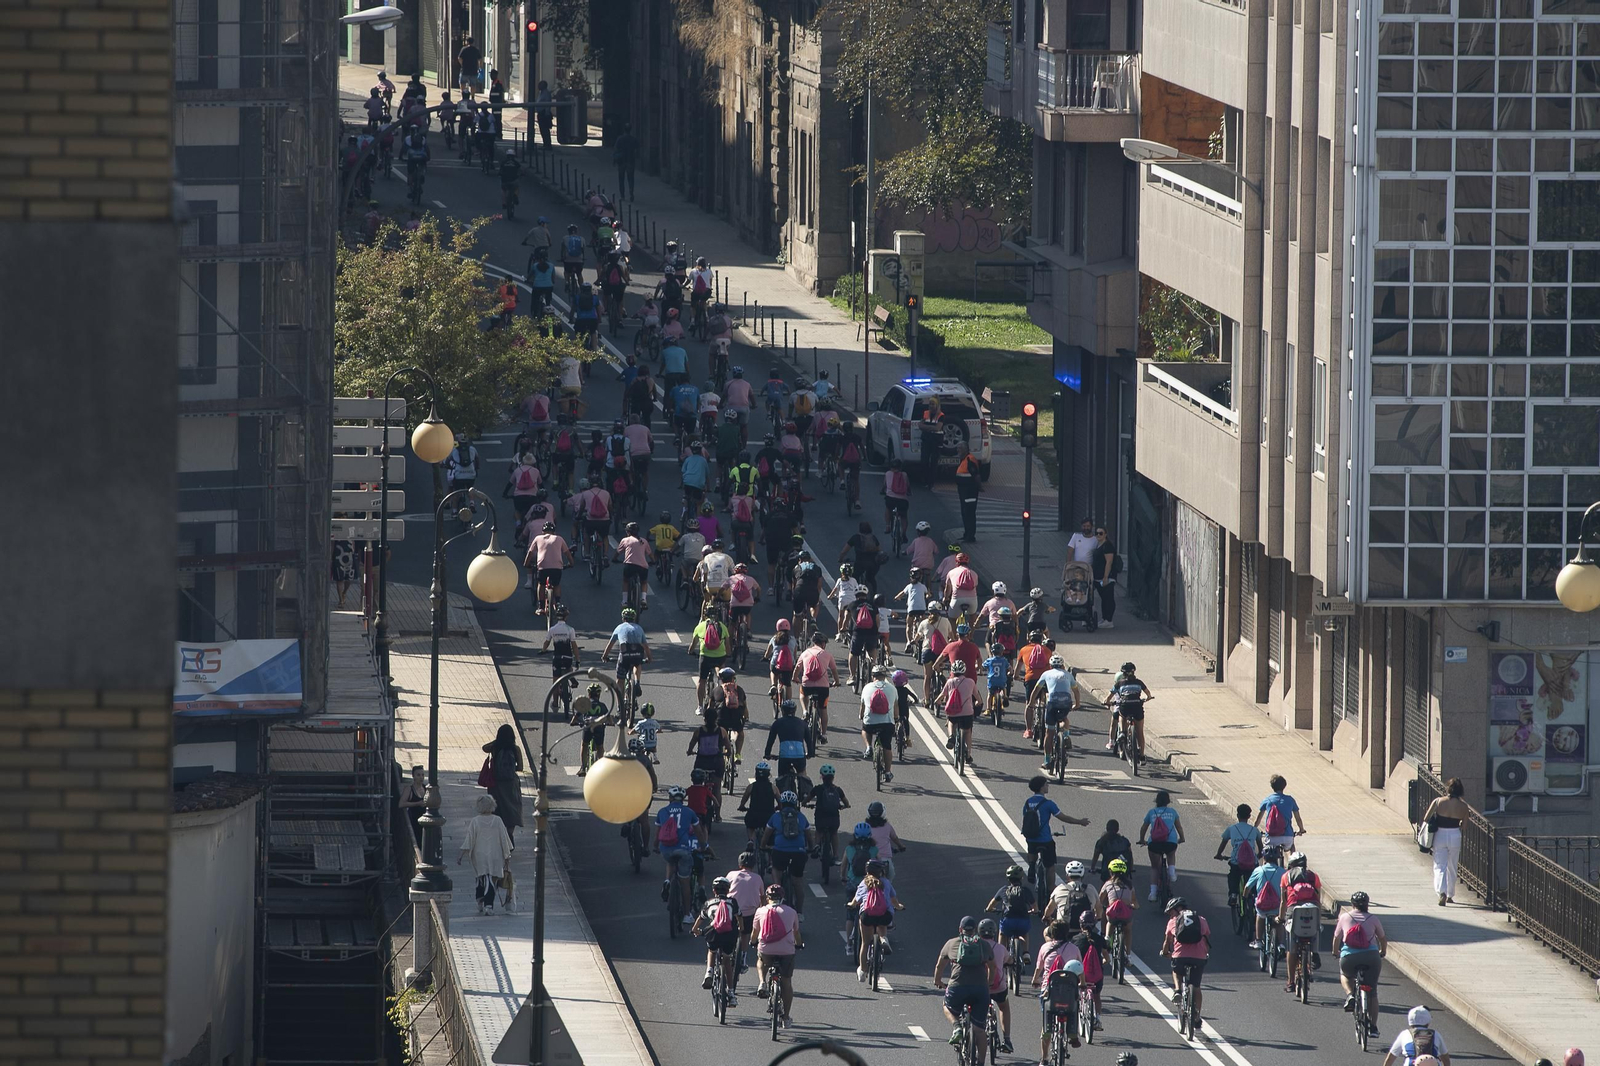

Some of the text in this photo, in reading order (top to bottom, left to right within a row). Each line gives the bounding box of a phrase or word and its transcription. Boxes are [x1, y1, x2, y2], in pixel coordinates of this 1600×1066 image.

[661, 527, 671, 539] 10
[993, 666, 1001, 677] 9
[645, 728, 655, 741] 18
